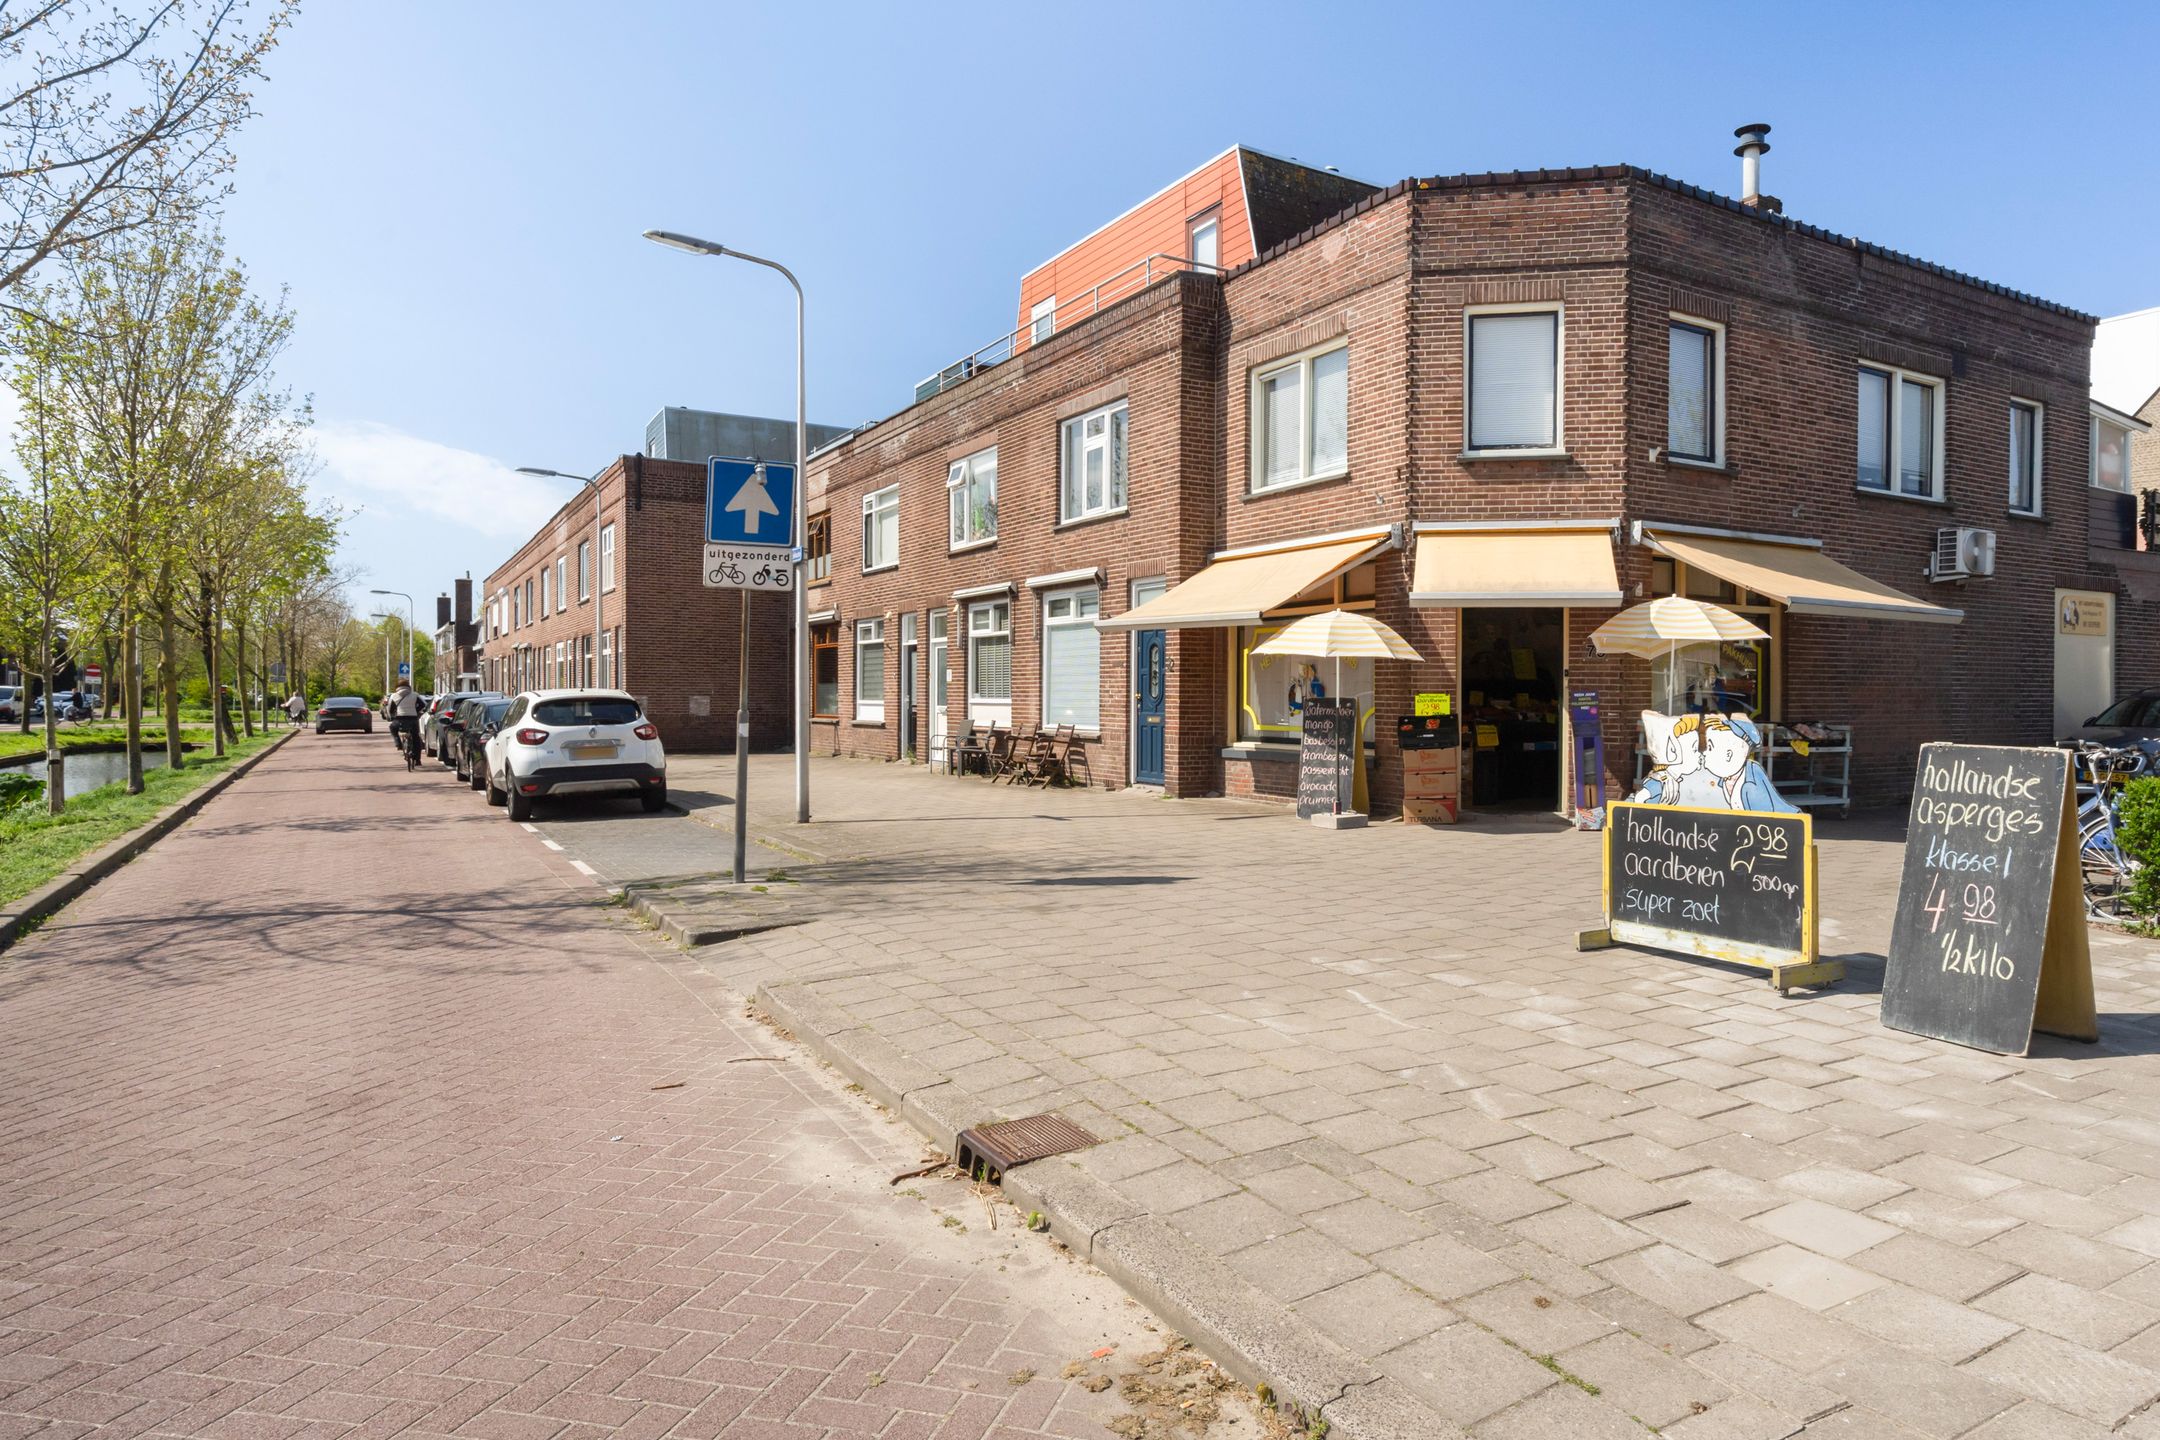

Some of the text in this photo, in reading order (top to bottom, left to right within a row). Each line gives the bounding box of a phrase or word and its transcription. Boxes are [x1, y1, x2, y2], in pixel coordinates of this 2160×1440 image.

[709, 549, 790, 562] uitgezonderd
[1586, 644, 1606, 658] 7
[1303, 733, 1346, 746] bosbessn
[1304, 720, 1334, 733] mango
[1922, 753, 2041, 800] hollandse
[1627, 807, 1719, 852] hollandse
[1917, 796, 2044, 842] asperges
[1757, 824, 1789, 852] 98
[1925, 835, 1997, 873] klasse
[1624, 851, 1725, 888] aardbeien
[1626, 888, 1720, 925] super zoet
[1924, 872, 1997, 934] 4 98
